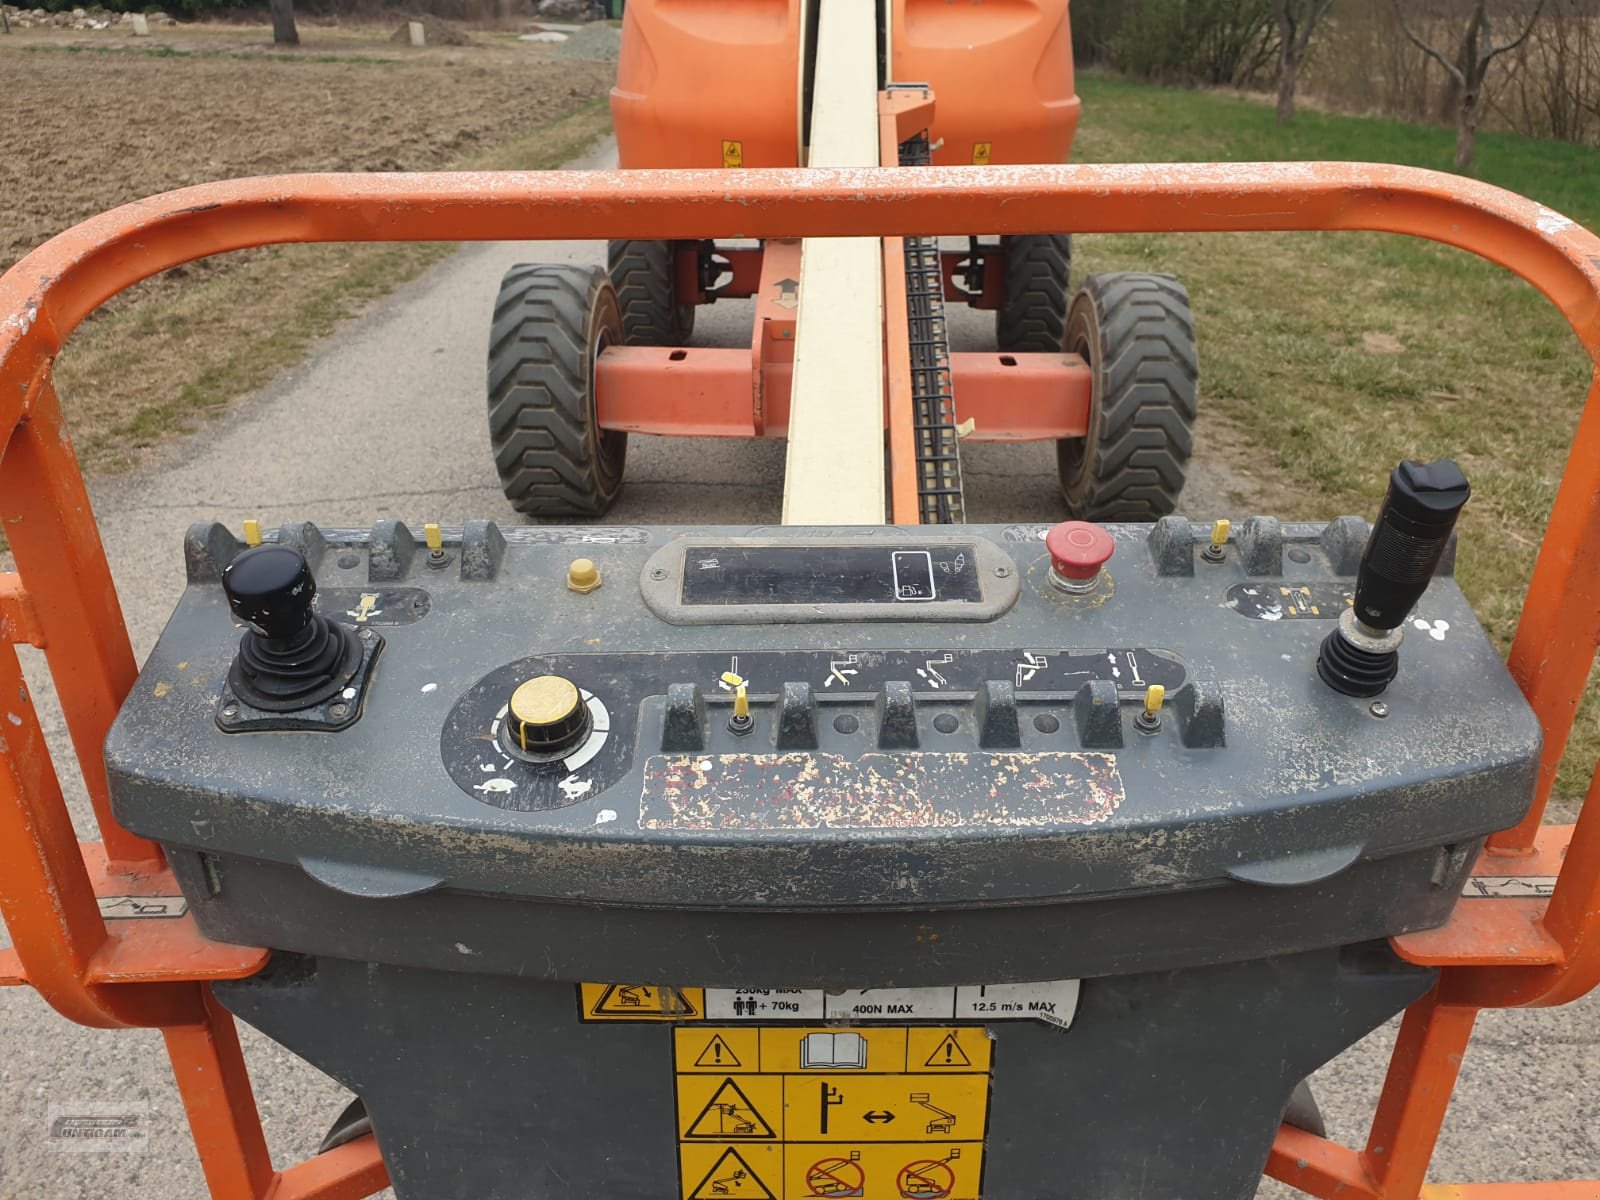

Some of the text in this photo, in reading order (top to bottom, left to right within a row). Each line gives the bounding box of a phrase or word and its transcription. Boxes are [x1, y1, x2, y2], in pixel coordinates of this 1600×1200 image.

[771, 1001, 800, 1012] 70kg
[852, 1004, 913, 1014] 400N MAX
[972, 1002, 1056, 1013] 12.5 m/s MAX
